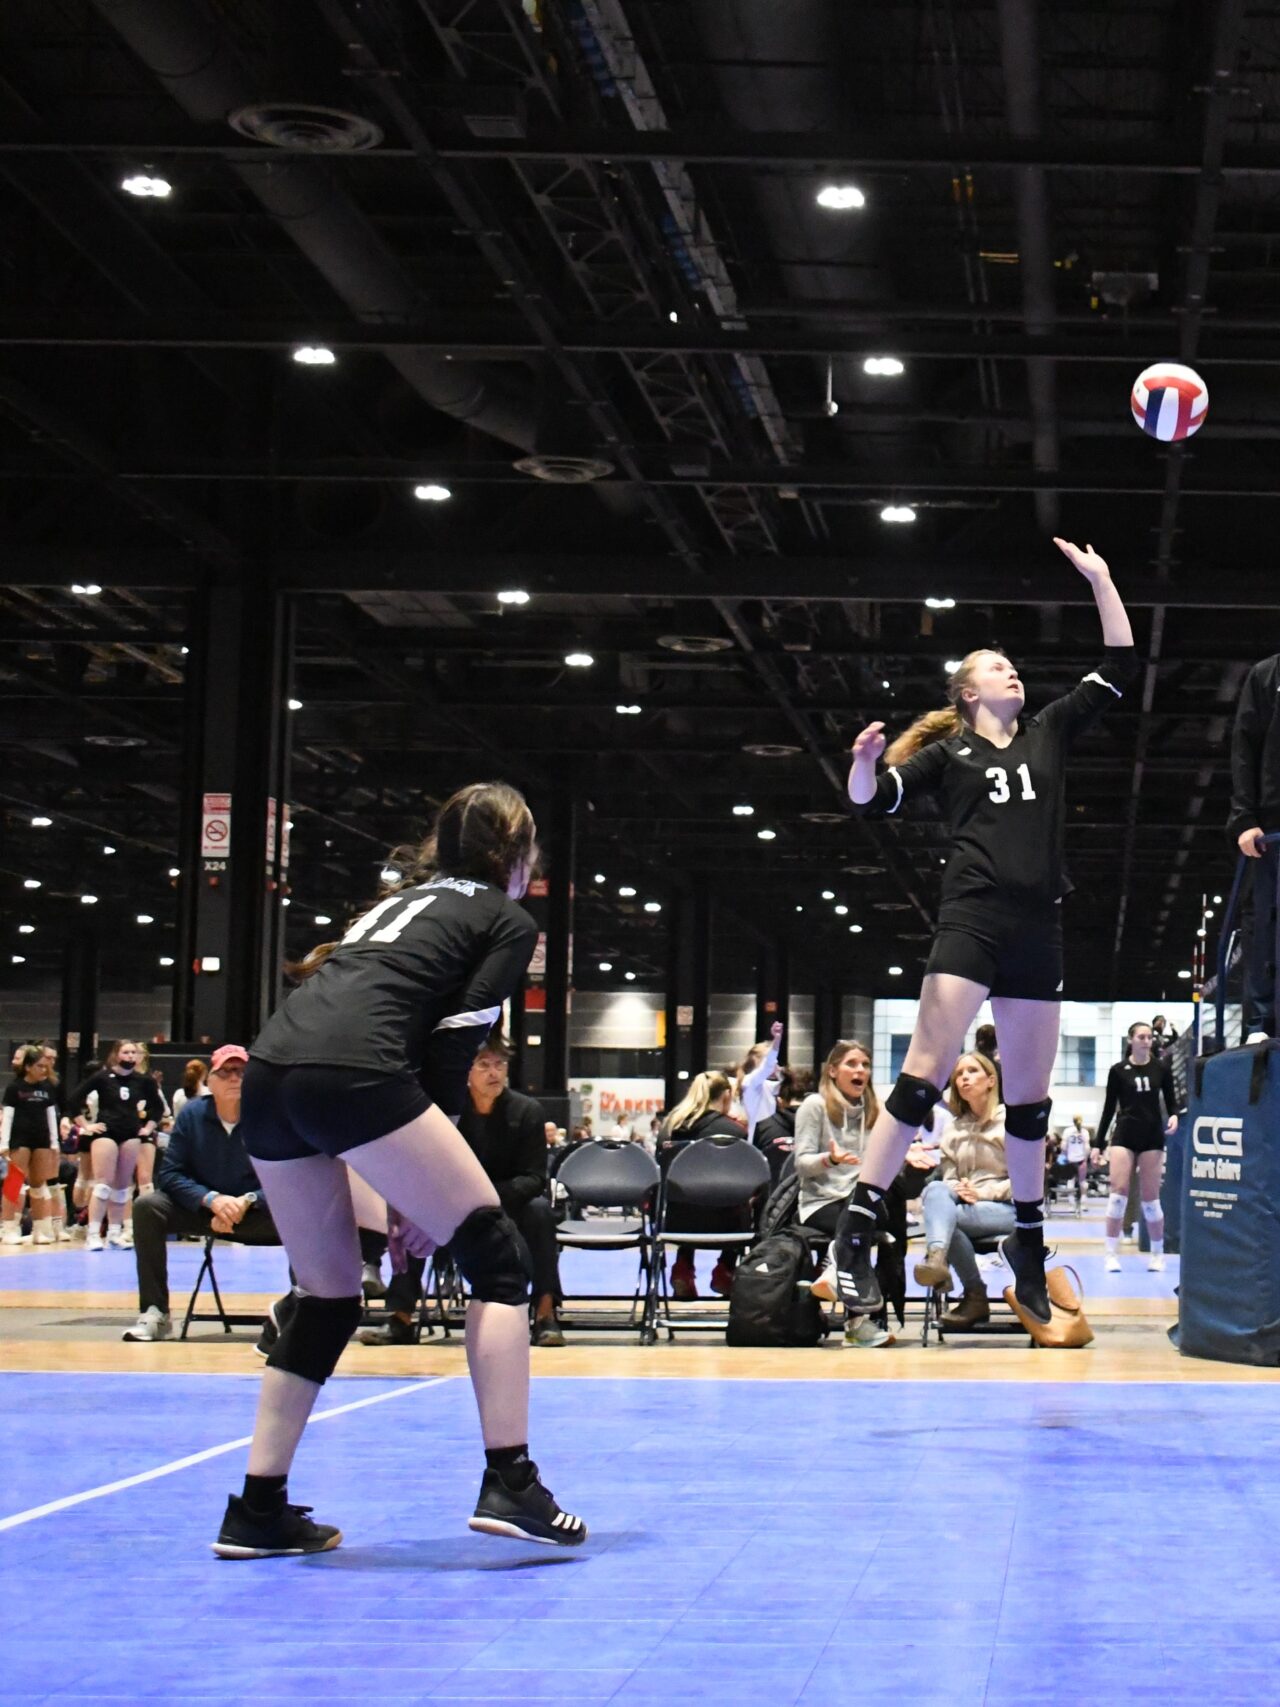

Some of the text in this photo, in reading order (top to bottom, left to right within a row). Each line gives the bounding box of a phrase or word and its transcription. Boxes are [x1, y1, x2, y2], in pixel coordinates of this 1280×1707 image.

[985, 763, 1036, 804] 31
[204, 861, 226, 871] X24
[1134, 1076, 1151, 1092] 11
[119, 1086, 130, 1100] 6
[1192, 1115, 1243, 1156] CG
